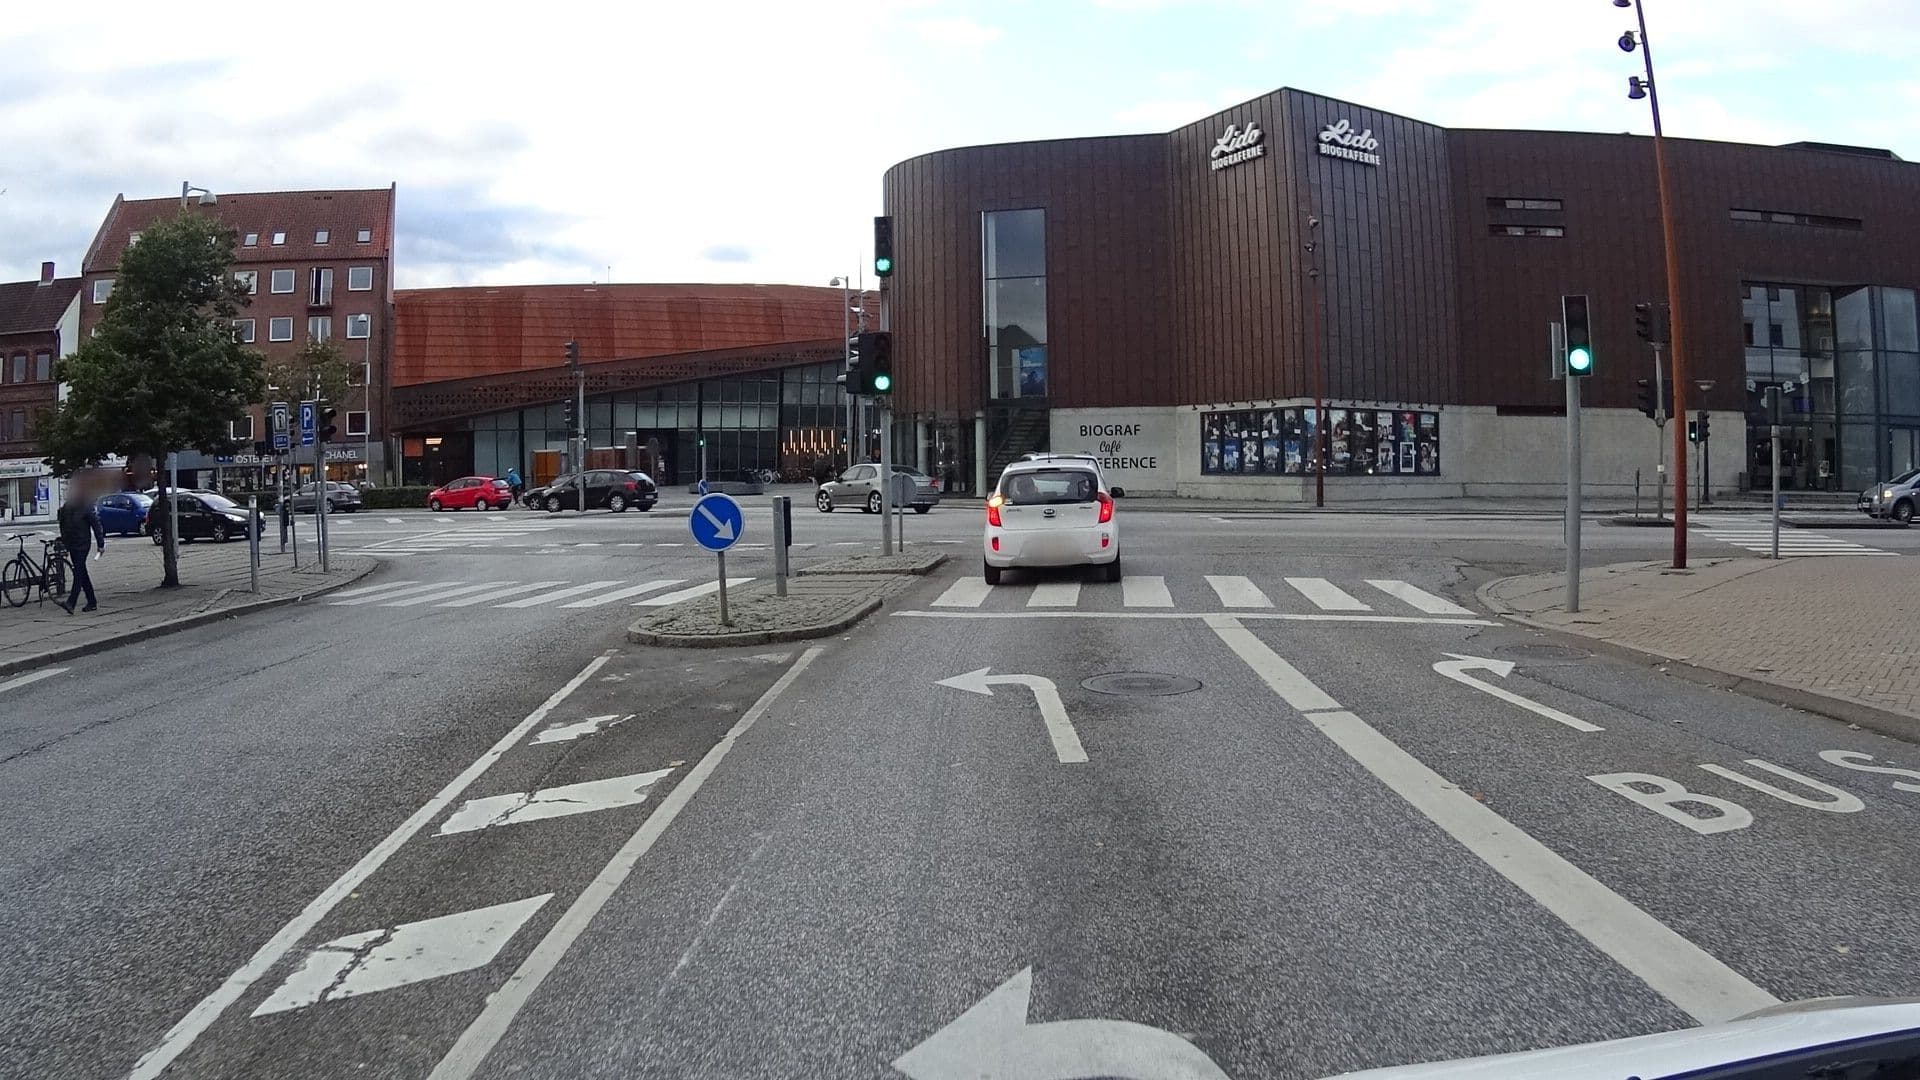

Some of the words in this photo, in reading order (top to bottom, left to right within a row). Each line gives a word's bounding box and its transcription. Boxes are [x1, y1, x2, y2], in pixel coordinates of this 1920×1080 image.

[1211, 122, 1262, 158] Lido
[1319, 119, 1378, 150] Lido
[1211, 145, 1264, 170] BIOGRAFERNE
[1319, 143, 1381, 166] BIOGRAFERNE
[303, 407, 311, 428] P
[1080, 424, 1141, 437] BIOGRAF
[1099, 440, 1121, 457] Café
[1585, 750, 1920, 834] BUS
